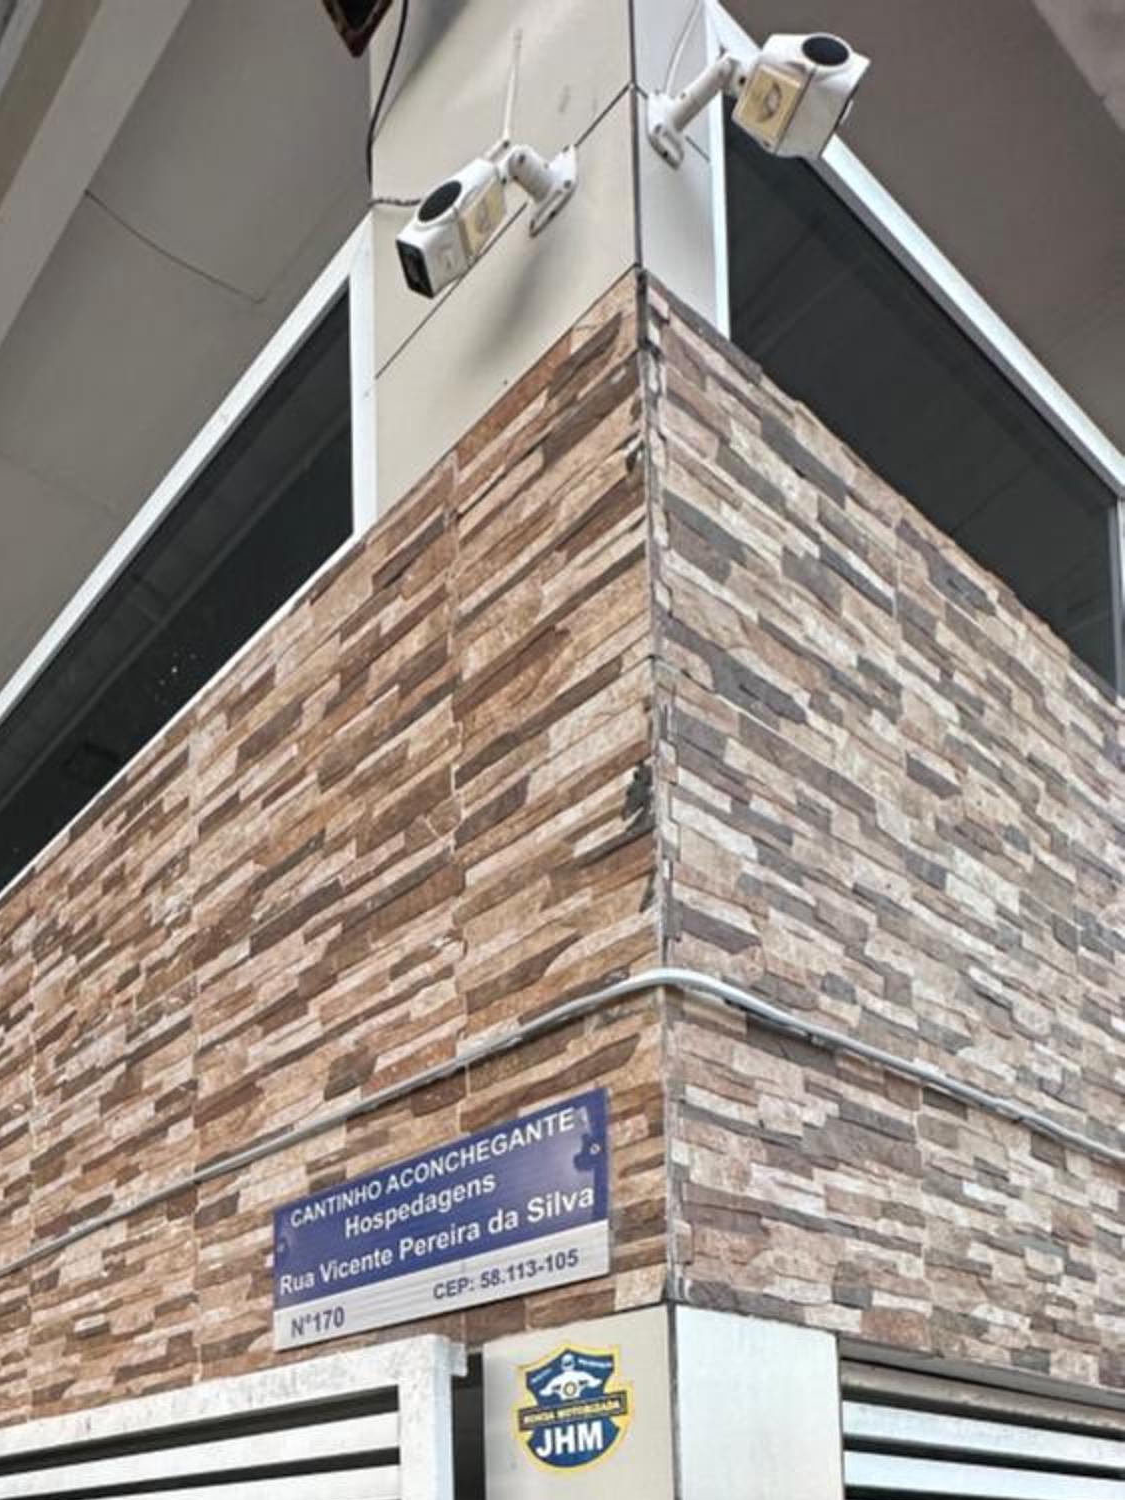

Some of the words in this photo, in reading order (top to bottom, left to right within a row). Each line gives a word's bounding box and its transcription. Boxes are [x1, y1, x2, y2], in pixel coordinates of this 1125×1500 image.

[290, 1181, 383, 1228] CANTINHO
[385, 1106, 576, 1195] ACONCHEGANTE
[345, 1173, 497, 1239] Hospedagens
[279, 1269, 315, 1296] Rua
[318, 1246, 393, 1284] Vicente
[399, 1218, 481, 1262] Pereira
[487, 1208, 520, 1236] da
[526, 1186, 595, 1224] Silva
[432, 1276, 476, 1301] CEP:
[479, 1249, 580, 1290] 58.113-105
[534, 1420, 604, 1458] JHM
